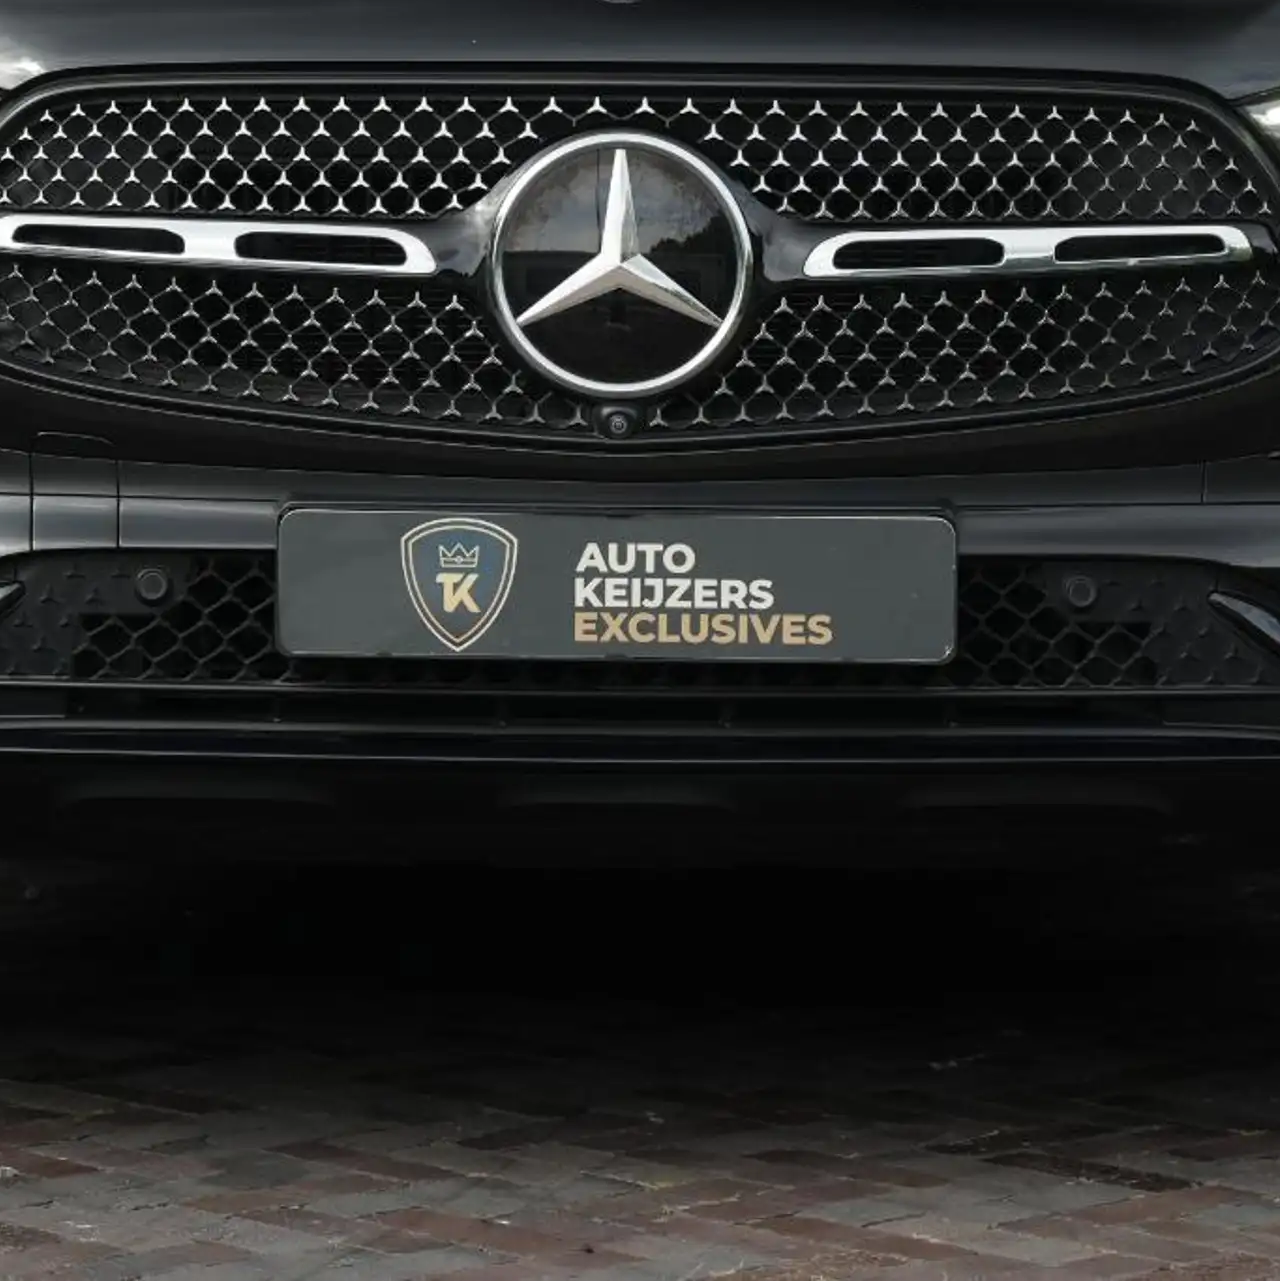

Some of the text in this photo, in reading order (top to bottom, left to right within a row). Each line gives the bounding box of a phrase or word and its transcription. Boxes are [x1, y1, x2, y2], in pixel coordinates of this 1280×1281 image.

[575, 542, 696, 575] AUTO
[574, 577, 775, 611] KEIJZERS
[574, 611, 834, 646] EXCLUSIVES
